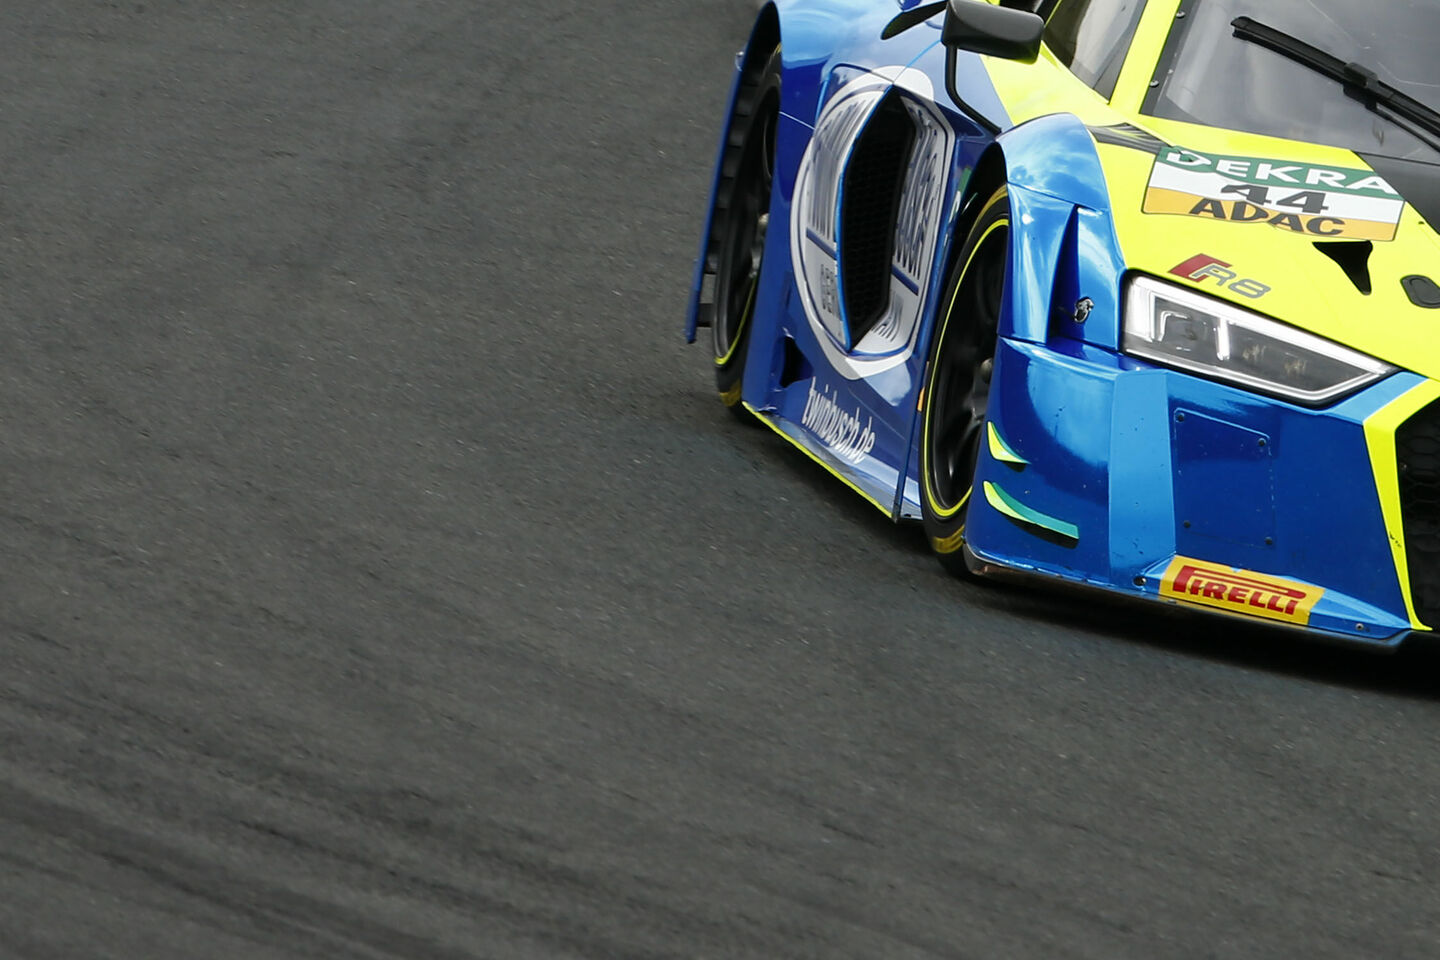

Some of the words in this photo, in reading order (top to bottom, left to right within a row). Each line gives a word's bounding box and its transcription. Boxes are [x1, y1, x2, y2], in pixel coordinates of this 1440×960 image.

[1166, 149, 1402, 195] DEKRA
[1189, 198, 1345, 236] ADAC
[1221, 184, 1329, 214] 44
[1188, 262, 1271, 299] R8
[801, 376, 876, 465] twinbusch.de
[1173, 565, 1307, 616] PIRELLI
